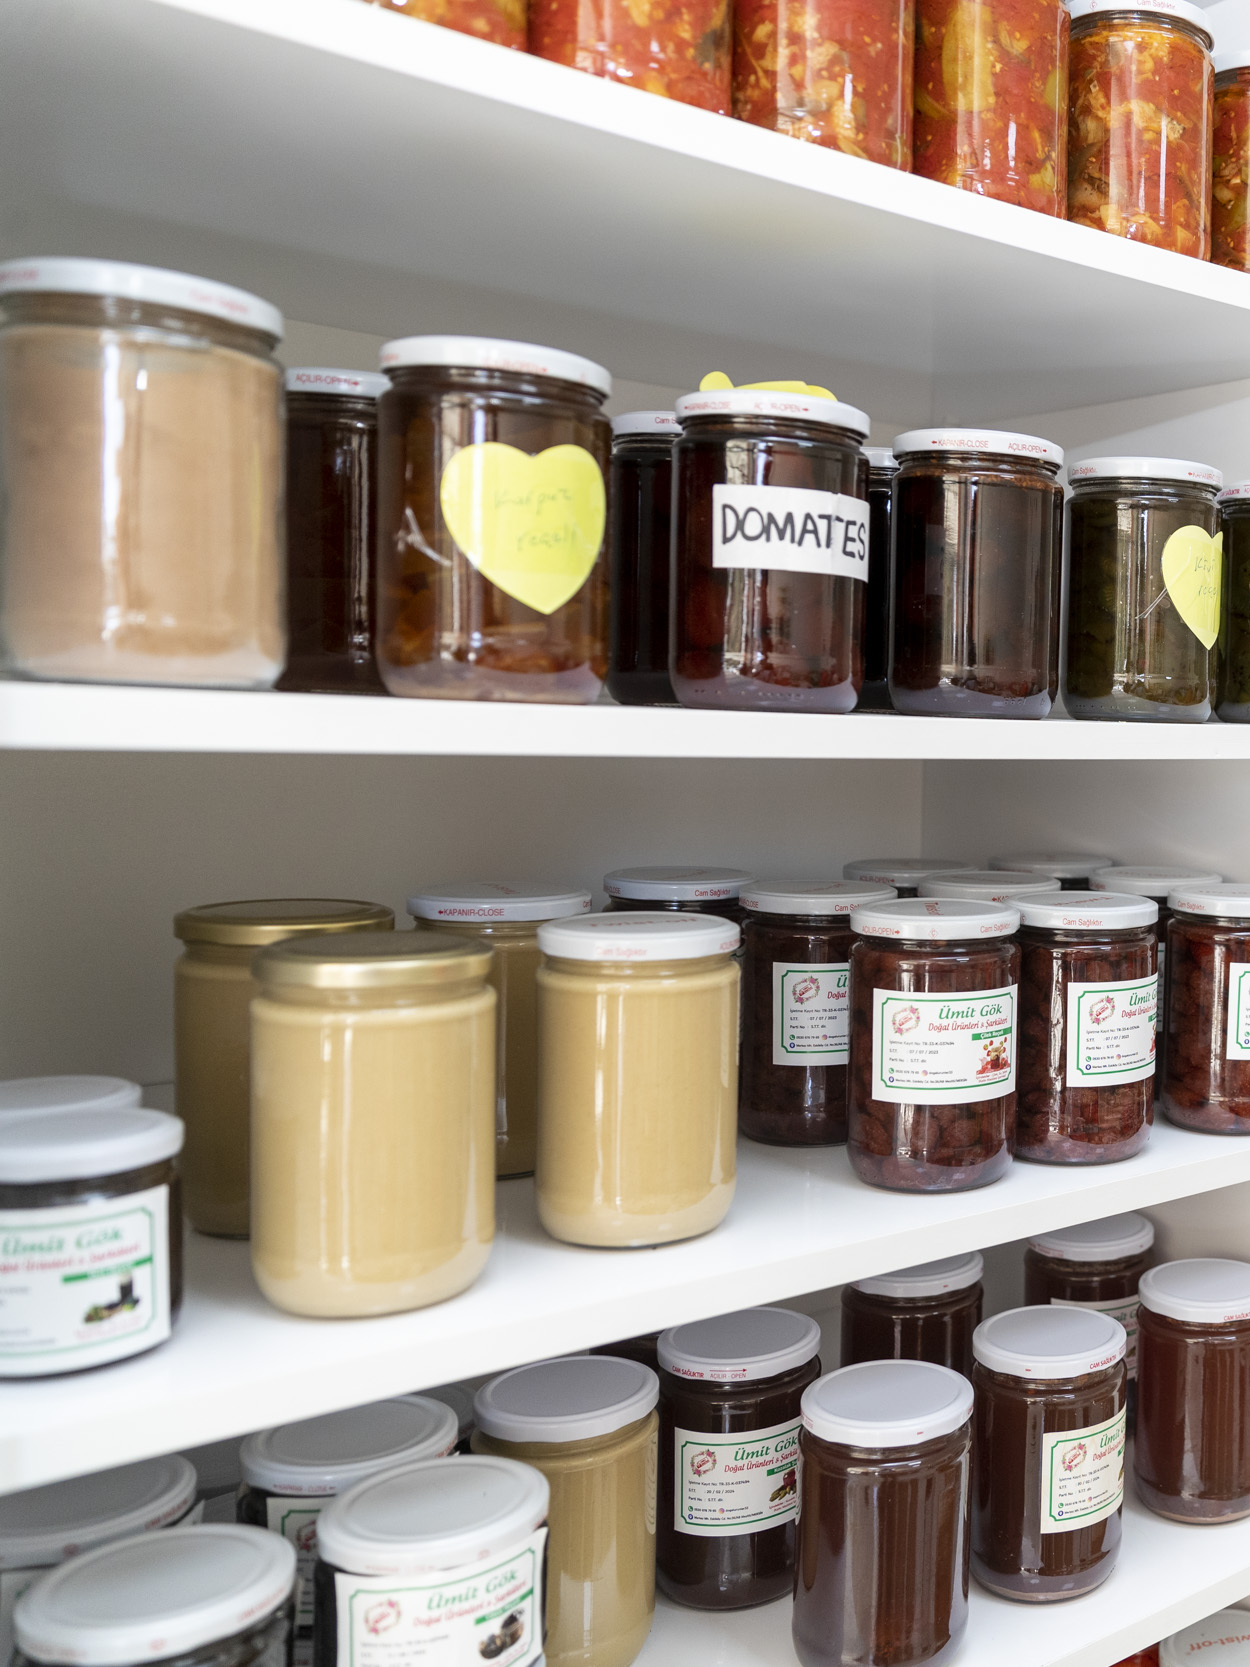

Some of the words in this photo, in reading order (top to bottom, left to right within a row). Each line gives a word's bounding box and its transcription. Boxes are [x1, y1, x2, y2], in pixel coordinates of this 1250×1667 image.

[655, 416, 669, 425] Cam
[938, 439, 989, 449] KAPANIR-CLOSE
[1008, 442, 1043, 454] AÇILIR-OPEN
[721, 503, 867, 562] DOMATES
[694, 889, 709, 897] Cam
[443, 908, 505, 917] KAPANIR-CLOSE
[834, 904, 849, 912] Cam
[1062, 917, 1077, 926] Cam
[979, 925, 993, 934] Cam
[1128, 991, 1152, 1006] Ümit
[938, 1004, 977, 1020] Ümit
[979, 1003, 1003, 1017] Gök
[928, 1022, 950, 1033] Doğal
[951, 1020, 980, 1031] Ürünleri
[984, 1016, 1009, 1030] Şarküteri
[1089, 1362, 1100, 1370] CAM
[733, 1445, 771, 1462] Ümit
[774, 1435, 799, 1453] Gök
[724, 1463, 745, 1474] Doğal
[746, 1457, 775, 1471] Ürünleri
[484, 1569, 519, 1594] Gök
